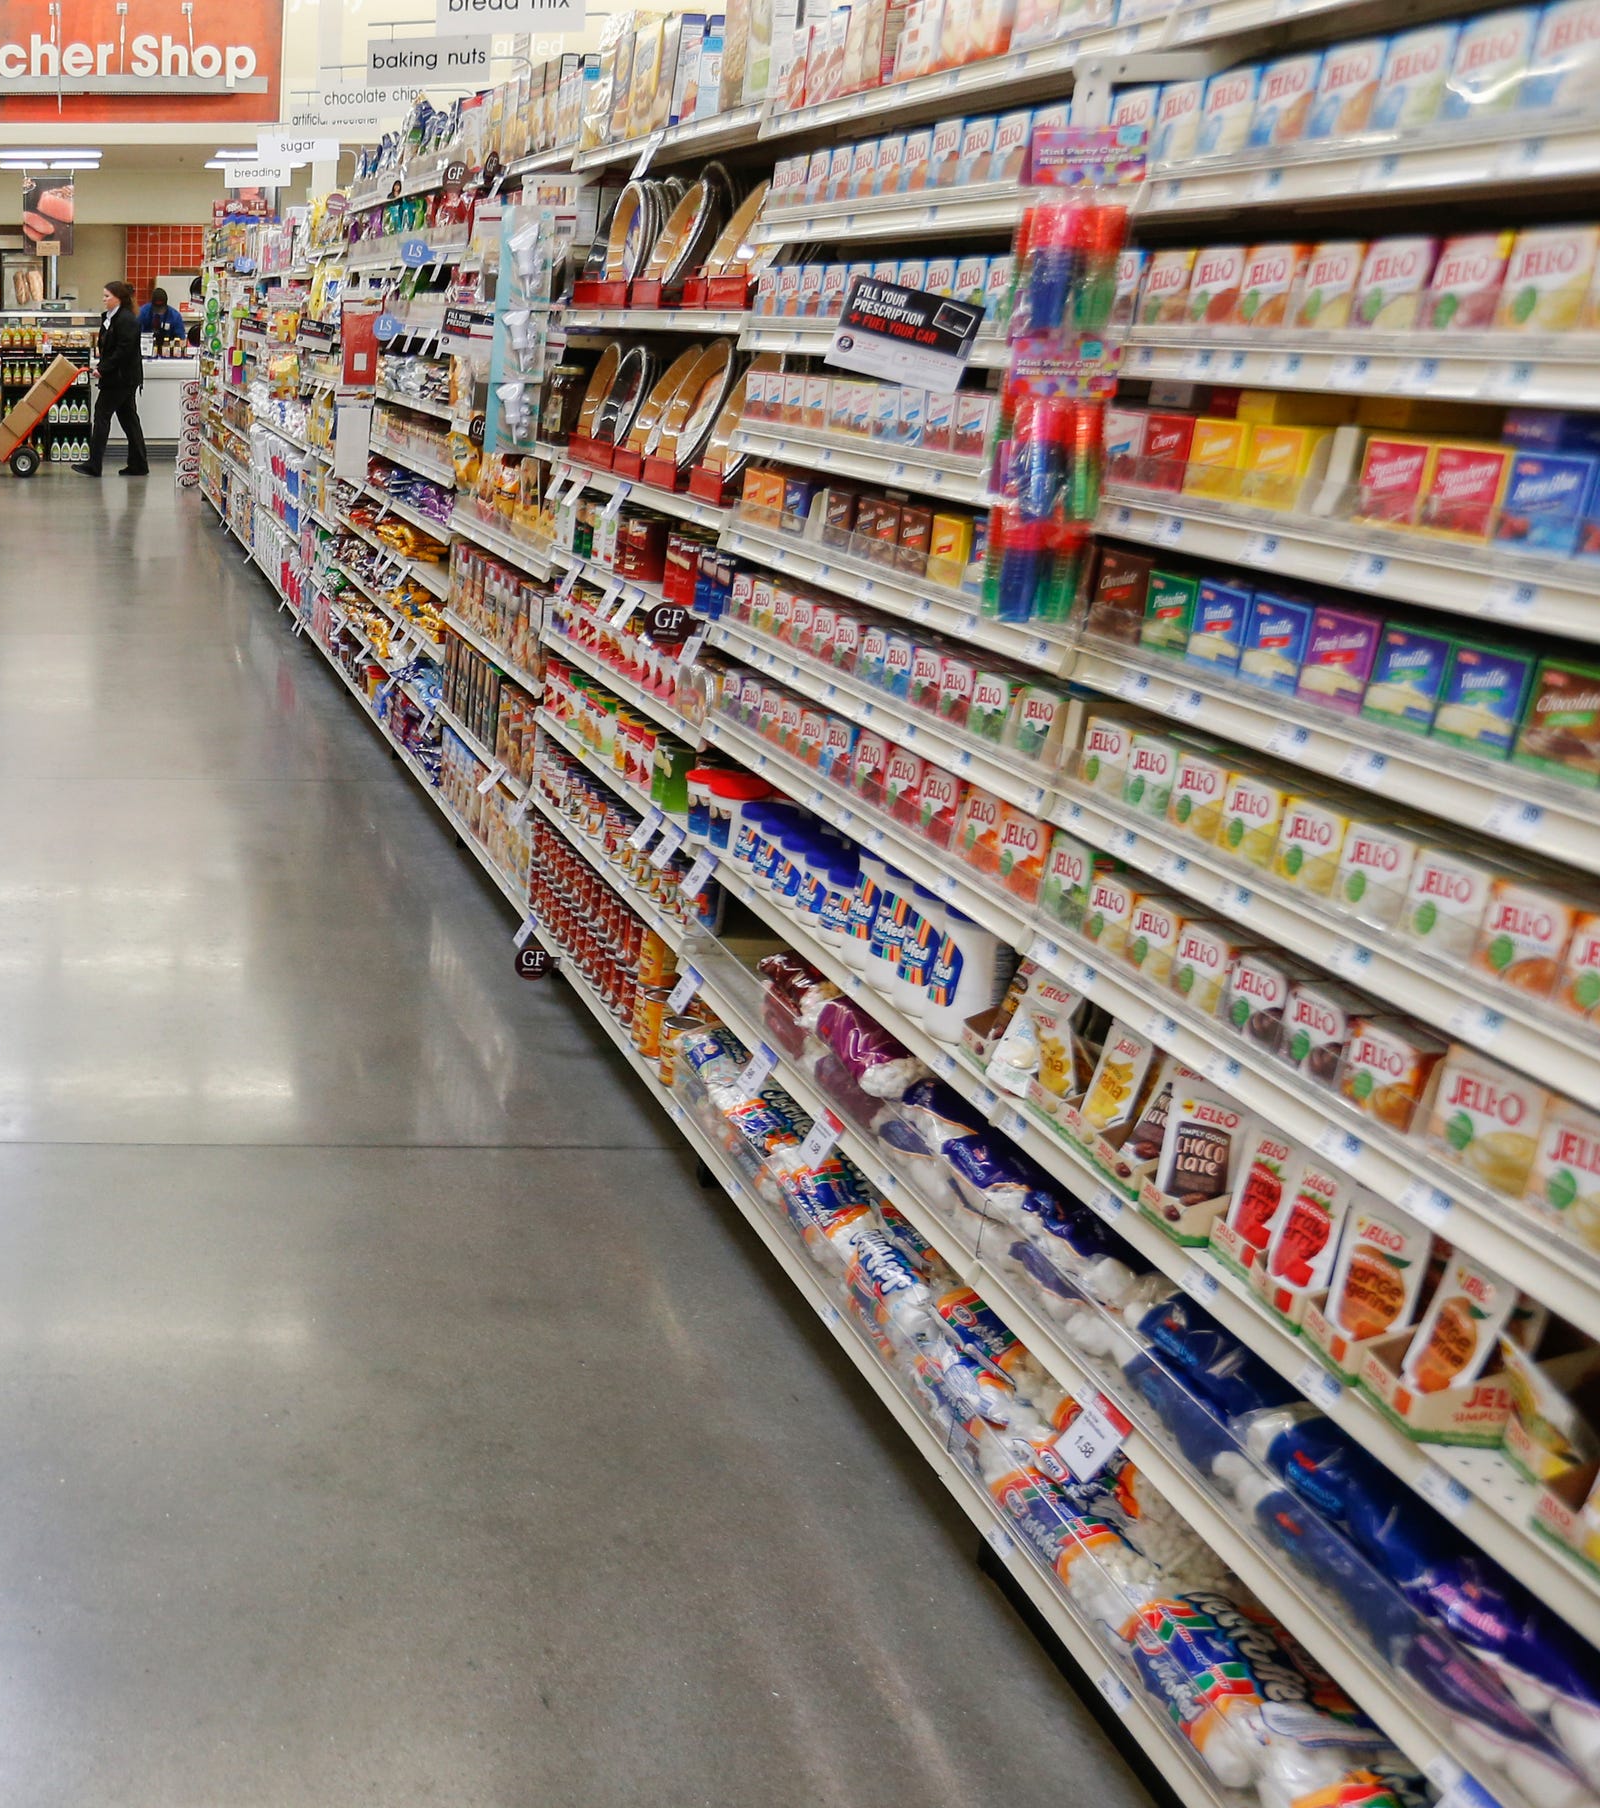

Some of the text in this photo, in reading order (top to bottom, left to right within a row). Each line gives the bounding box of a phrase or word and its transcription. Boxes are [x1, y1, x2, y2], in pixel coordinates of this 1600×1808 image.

[131, 33, 257, 87] Shop
[372, 48, 487, 70] baking nuts
[324, 86, 424, 106] chocolate chips
[280, 139, 316, 154] sugar
[234, 166, 281, 181] breading
[448, 166, 464, 180] GF
[408, 244, 423, 258] LS
[857, 284, 909, 308] FILL YOUR
[852, 297, 925, 327] PRESCRIPTION
[380, 319, 392, 331] LS
[862, 315, 887, 333] FUEL
[888, 322, 916, 339] YOUR
[915, 329, 939, 345] CAR
[655, 607, 685, 629] GF
[1204, 604, 1234, 621] Vanilla
[1259, 619, 1293, 636] Vanilla
[1389, 648, 1433, 669] Vanilla
[1461, 669, 1509, 690] Vanilla
[522, 950, 544, 966] GF
[1074, 1434, 1095, 1458] 1.58
[1043, 1454, 1061, 1475] Kraft
